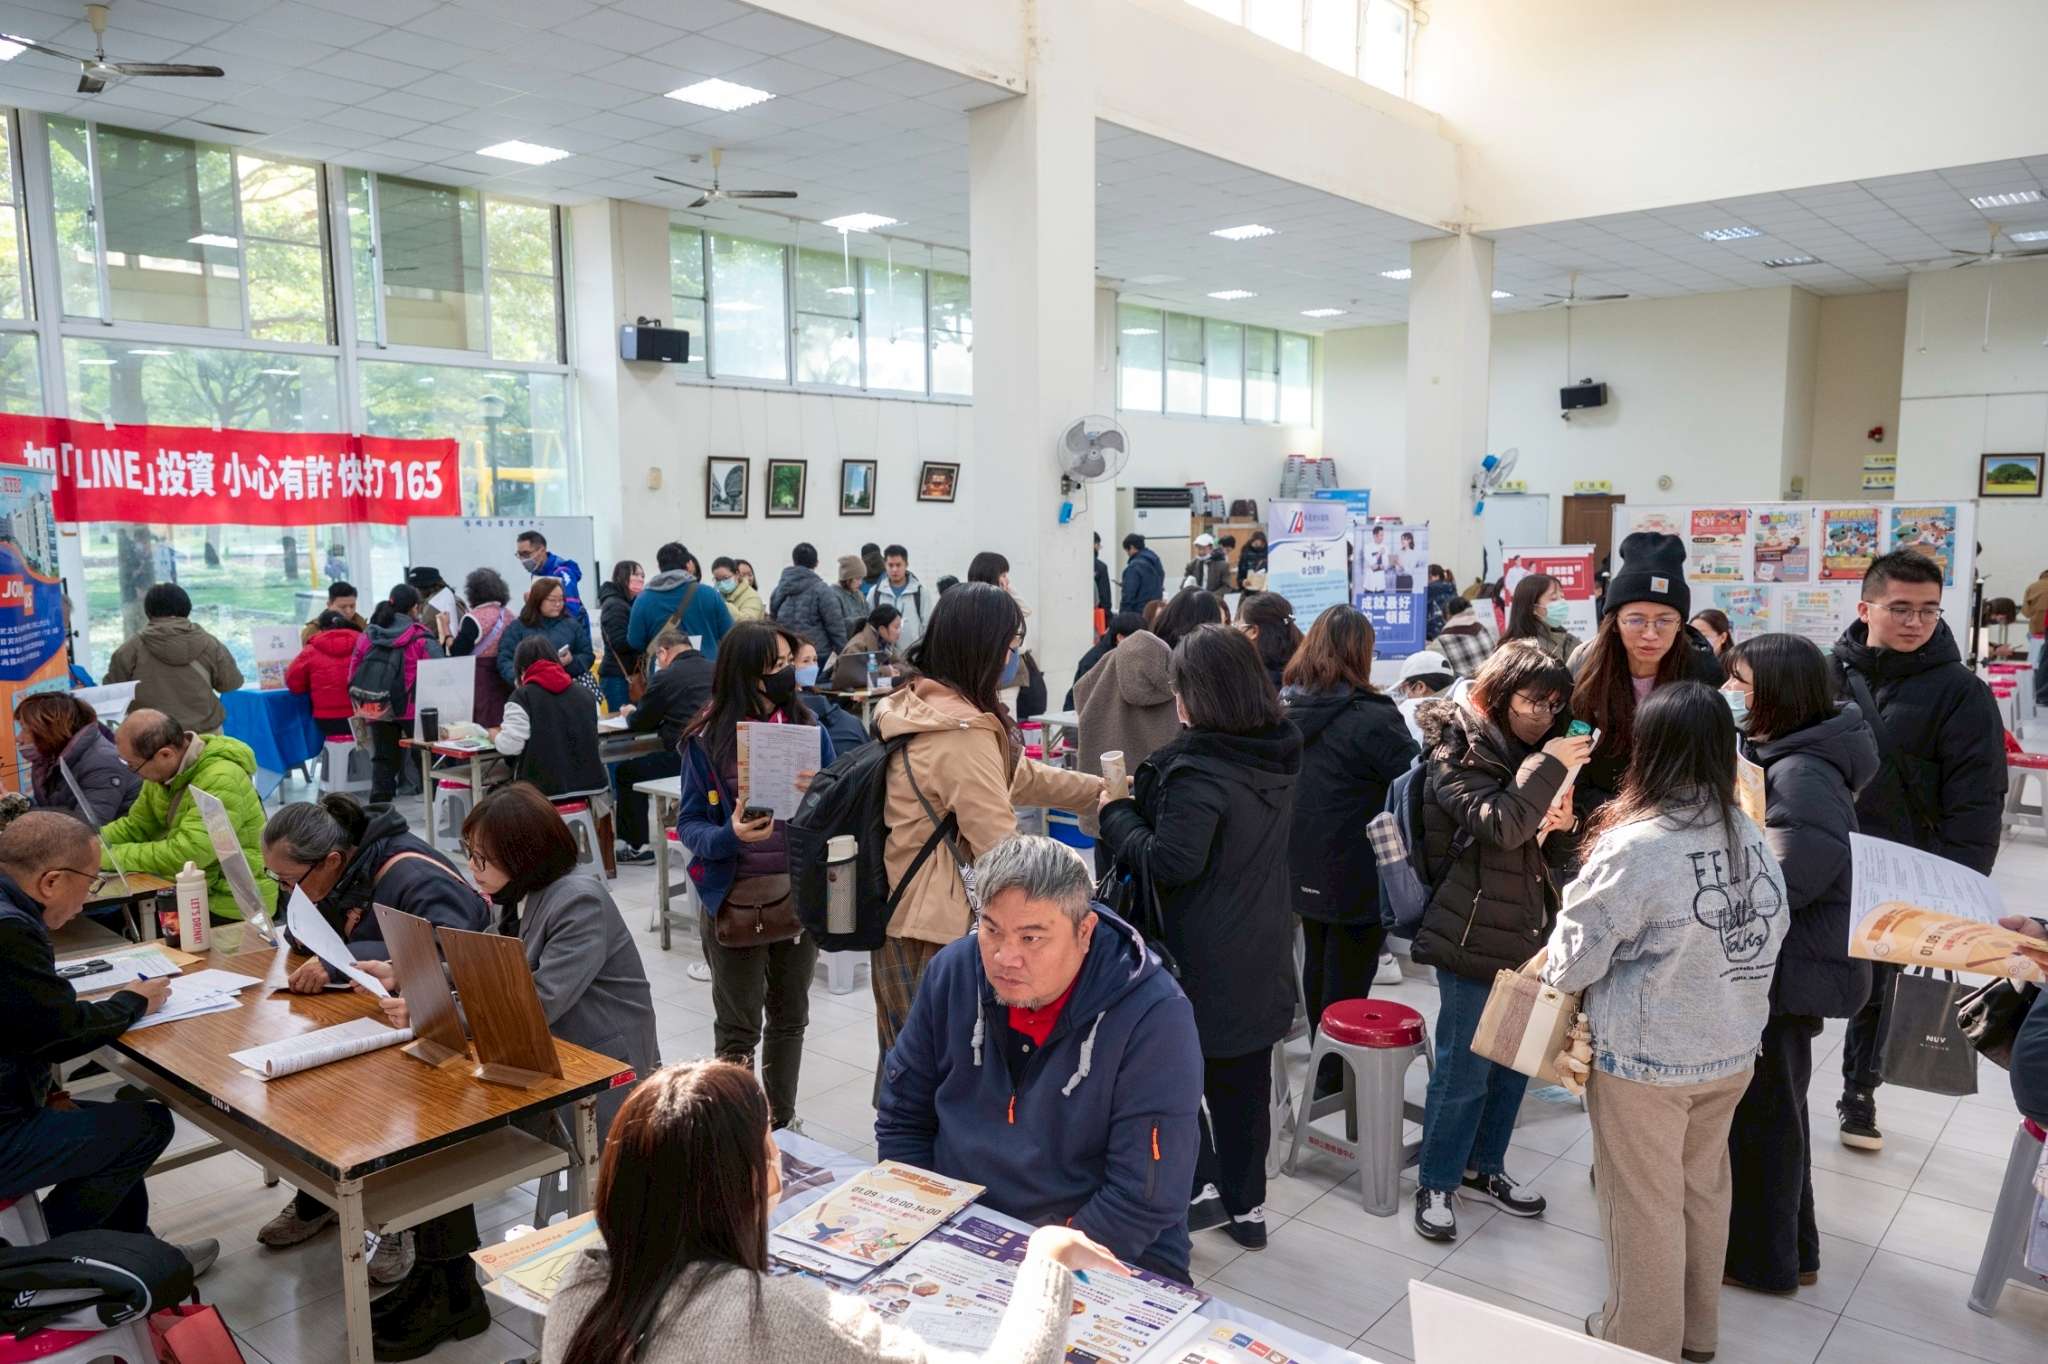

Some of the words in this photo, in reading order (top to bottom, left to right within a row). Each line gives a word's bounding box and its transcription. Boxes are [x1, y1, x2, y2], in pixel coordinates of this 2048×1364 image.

[222, 451, 333, 501] 小心有詐
[1361, 595, 1412, 610] 成就最好
[851, 1185, 878, 1198] 01.09
